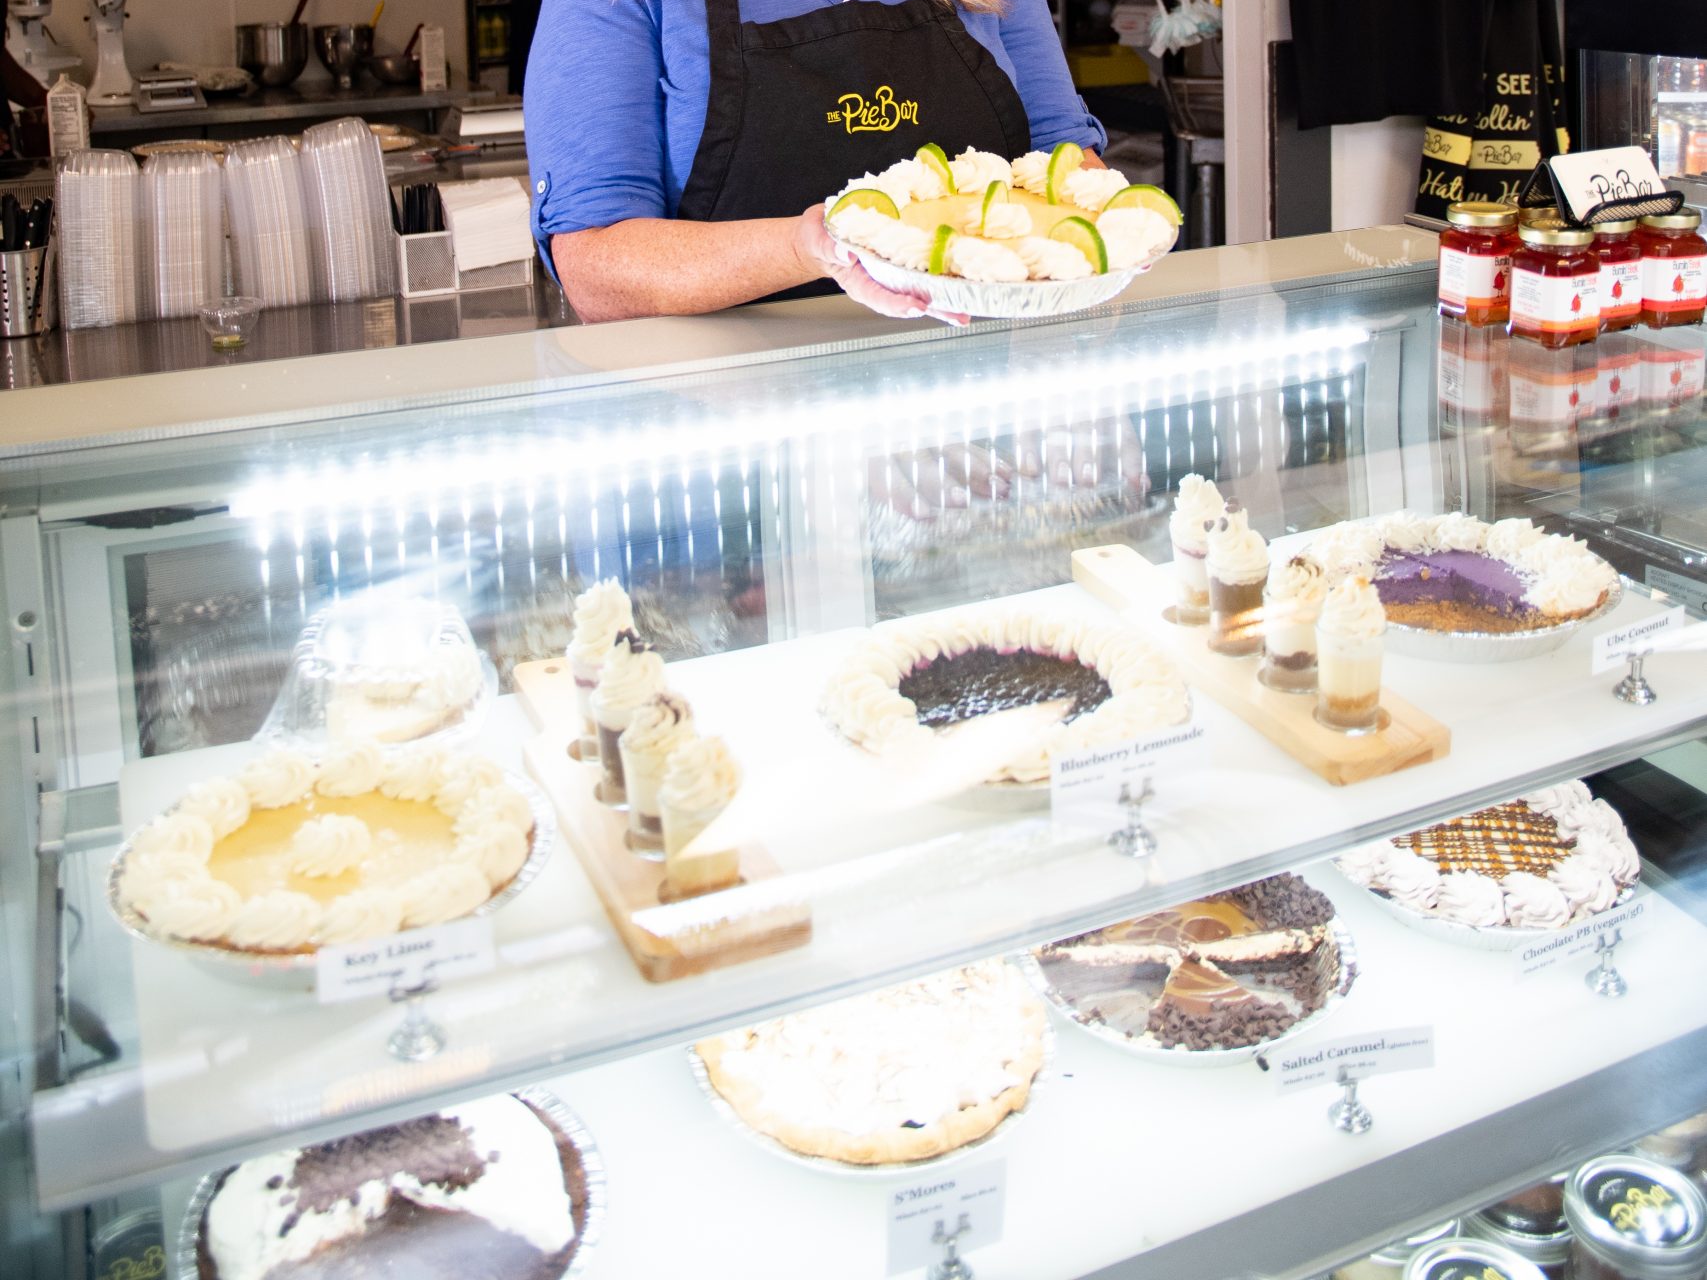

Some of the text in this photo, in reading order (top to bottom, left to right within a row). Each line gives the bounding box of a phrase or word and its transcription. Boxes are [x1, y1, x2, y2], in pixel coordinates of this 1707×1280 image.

[1496, 72, 1531, 95] SEE
[826, 111, 841, 123] THE
[1474, 104, 1534, 131] ollin'
[1606, 616, 1669, 647] Ube Coconut
[1060, 747, 1130, 773] Blueberry
[1135, 727, 1204, 754] Lemonade
[1522, 903, 1644, 961] Chocolate PB (vegan/gf)
[344, 939, 435, 967] Key Lime
[1281, 1050, 1324, 1071] Salted
[1327, 1038, 1386, 1059] Caramel
[895, 1180, 956, 1206] S'Mores
